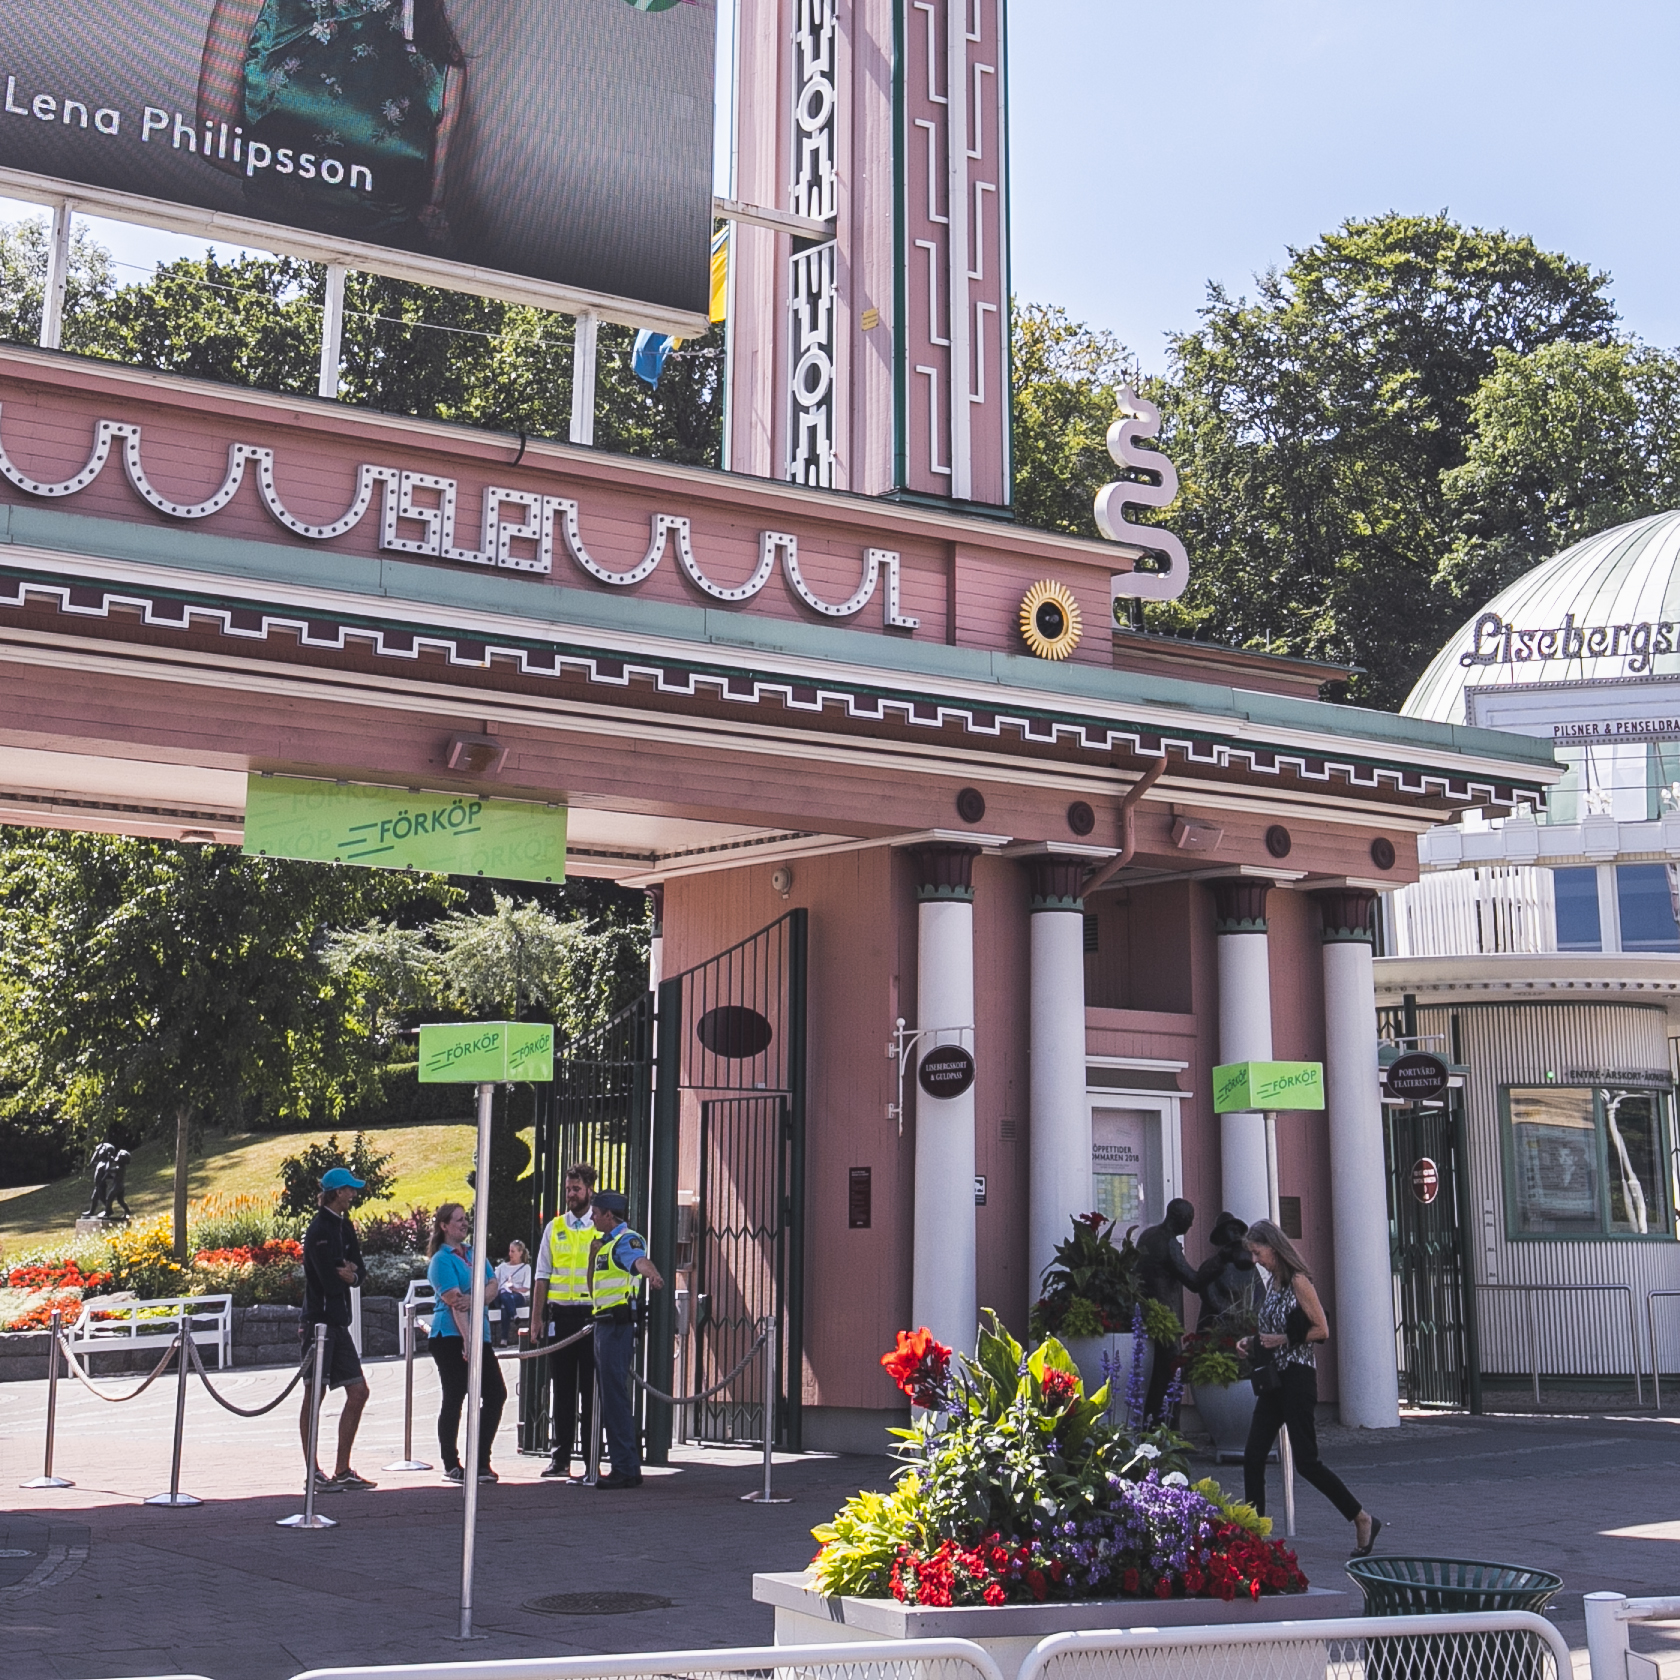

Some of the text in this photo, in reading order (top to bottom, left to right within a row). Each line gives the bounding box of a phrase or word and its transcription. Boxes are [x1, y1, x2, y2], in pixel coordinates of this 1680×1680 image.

[5, 75, 372, 191] Lena Philipsson
[1553, 722, 1599, 737] PILSNER
[1604, 722, 1612, 735] &
[380, 798, 482, 843] FÖRKÖP
[446, 1033, 499, 1062] FÖRKÖP
[520, 1034, 550, 1060] FÖRKÖP
[1224, 1069, 1247, 1095] FÖRKÖP
[1273, 1069, 1317, 1091] FÖRKÖP
[1393, 1077, 1442, 1088] TEATERENTRÉ
[1570, 1068, 1600, 1079] ENTRÉ
[1605, 1069, 1641, 1080] ÅRSKORT
[1093, 1144, 1132, 1154] ÖPPETTIDER
